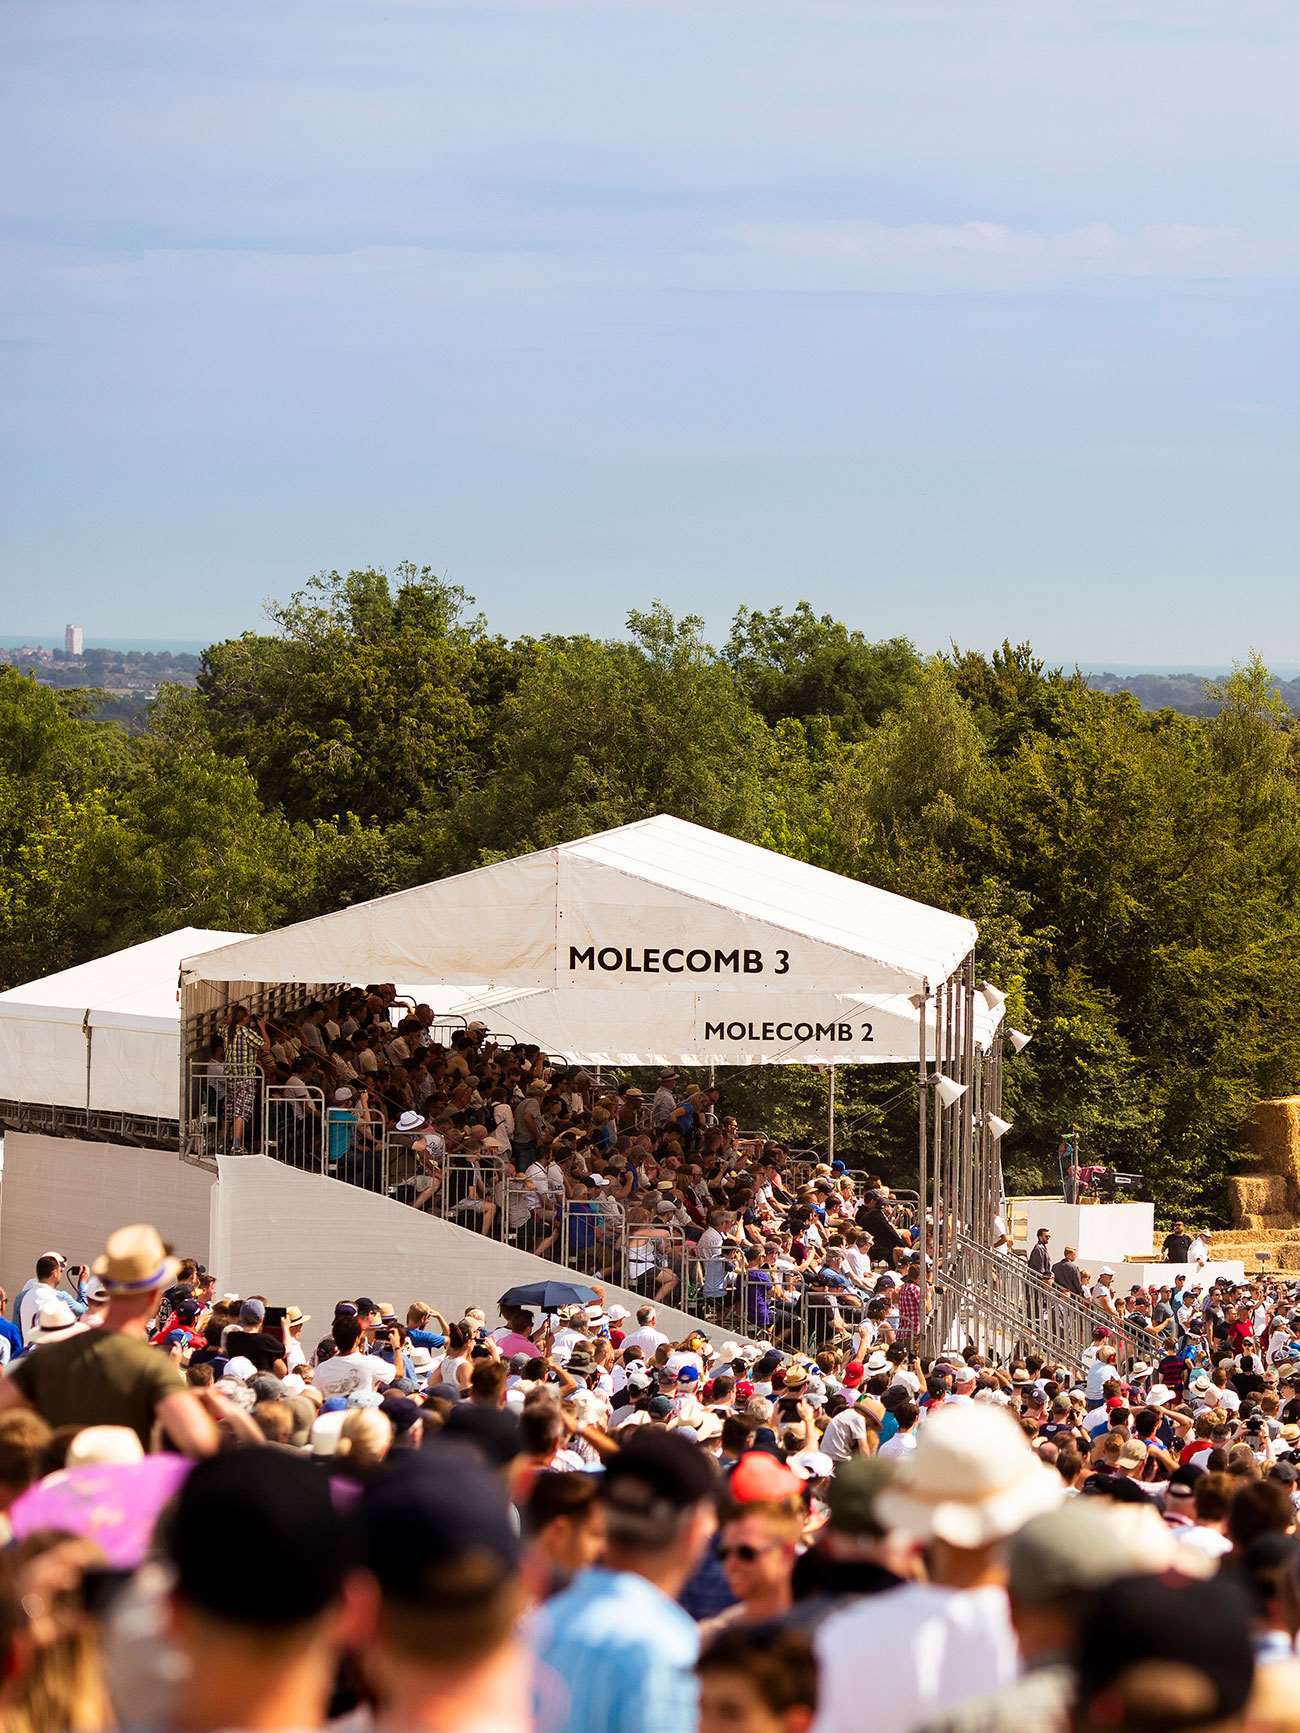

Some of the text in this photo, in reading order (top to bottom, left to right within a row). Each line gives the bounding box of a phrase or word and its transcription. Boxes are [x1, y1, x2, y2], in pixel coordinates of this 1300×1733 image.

[569, 946, 790, 975] MOLECOMB 3
[704, 1021, 874, 1043] MOLECOMB 2
